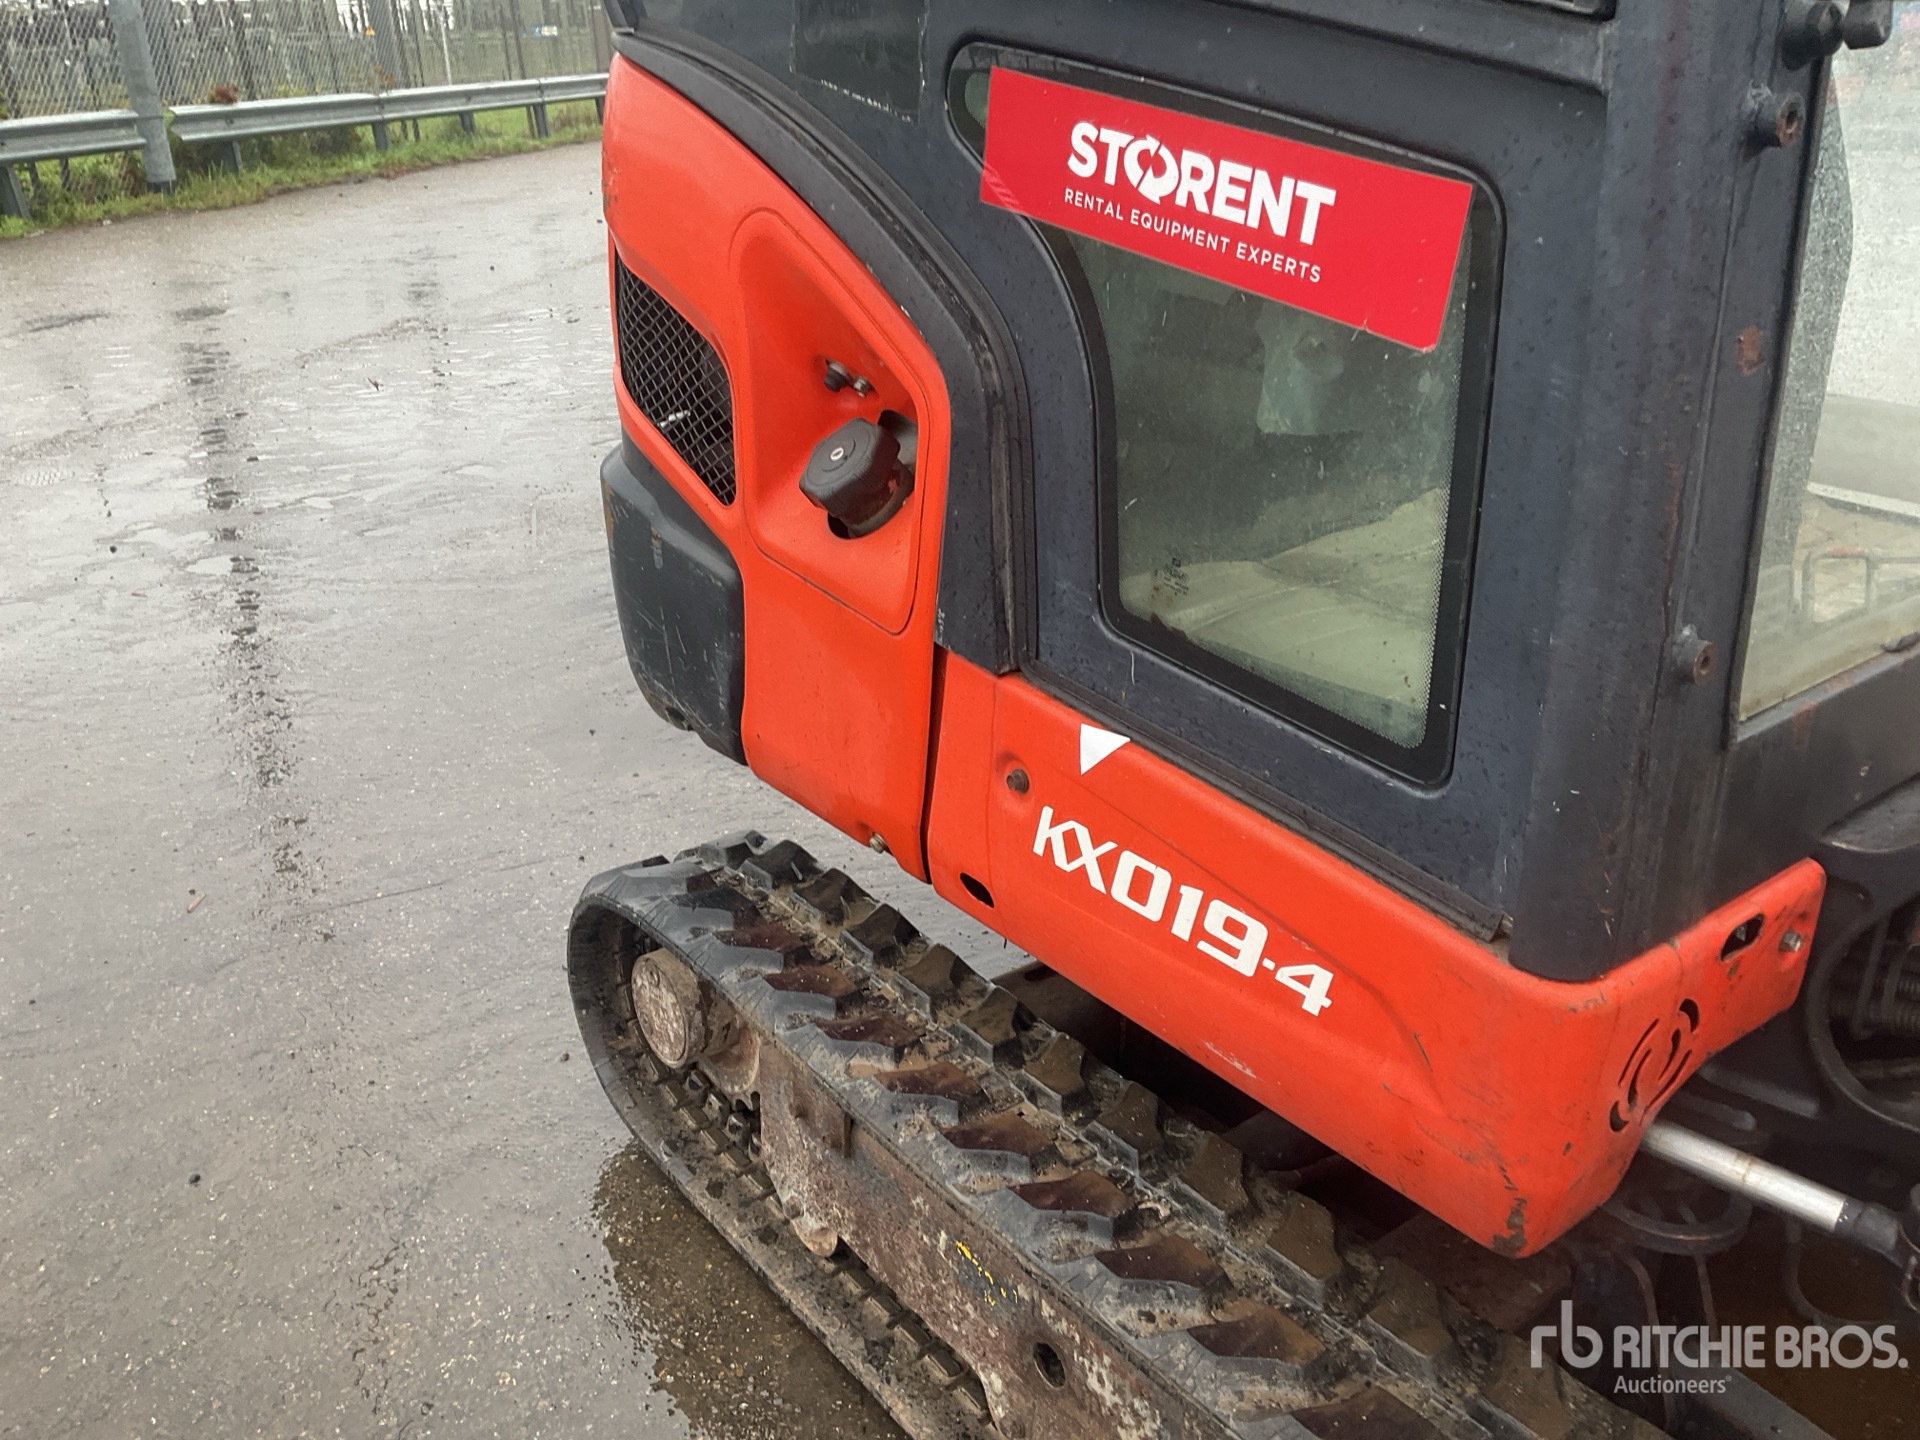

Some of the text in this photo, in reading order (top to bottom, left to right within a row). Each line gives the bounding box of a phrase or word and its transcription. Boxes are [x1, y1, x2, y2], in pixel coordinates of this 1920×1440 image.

[1064, 188, 1322, 284] RENTAL EQUIPMENT EXPERTS
[1067, 121, 1336, 246] STORENT
[1033, 805, 1334, 1017] KX019-4
